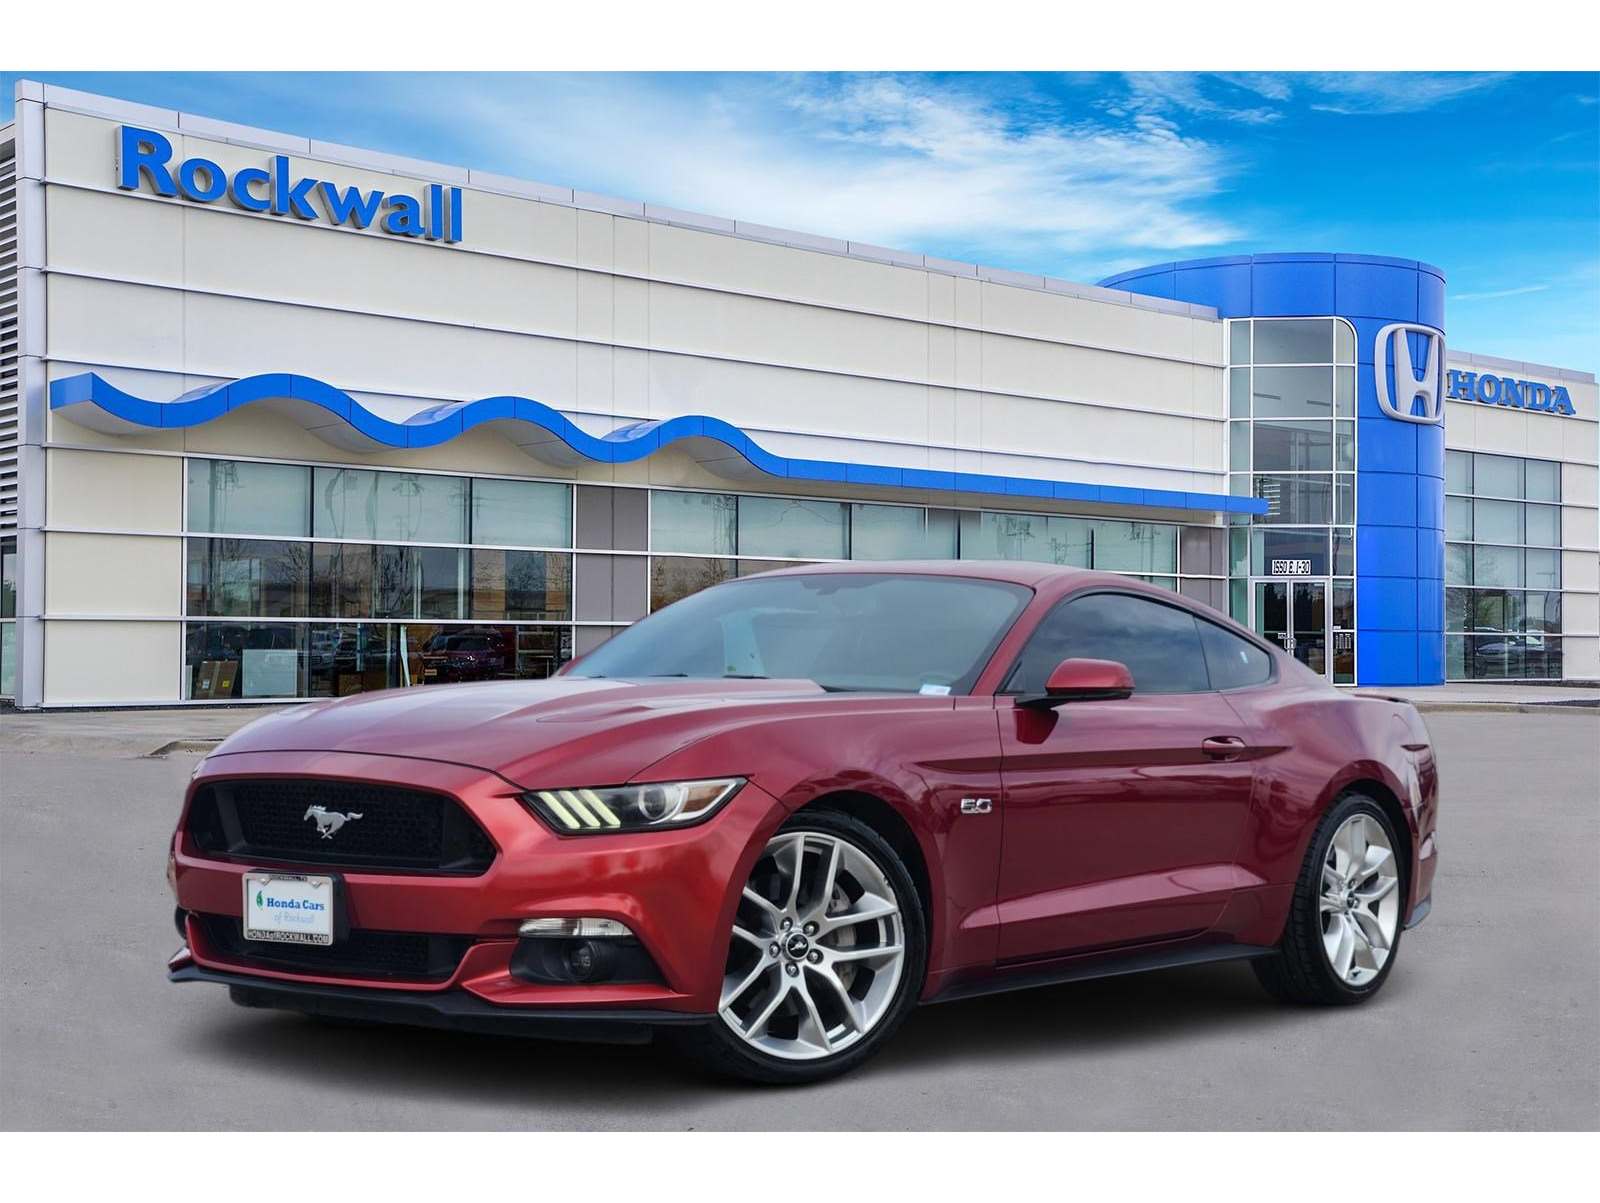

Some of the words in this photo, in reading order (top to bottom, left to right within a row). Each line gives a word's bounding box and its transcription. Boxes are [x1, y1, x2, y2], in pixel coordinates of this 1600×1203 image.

[117, 124, 463, 243] Rockwall
[1447, 369, 1576, 415] HONDA
[266, 897, 301, 909] Honda
[302, 899, 325, 911] Cars
